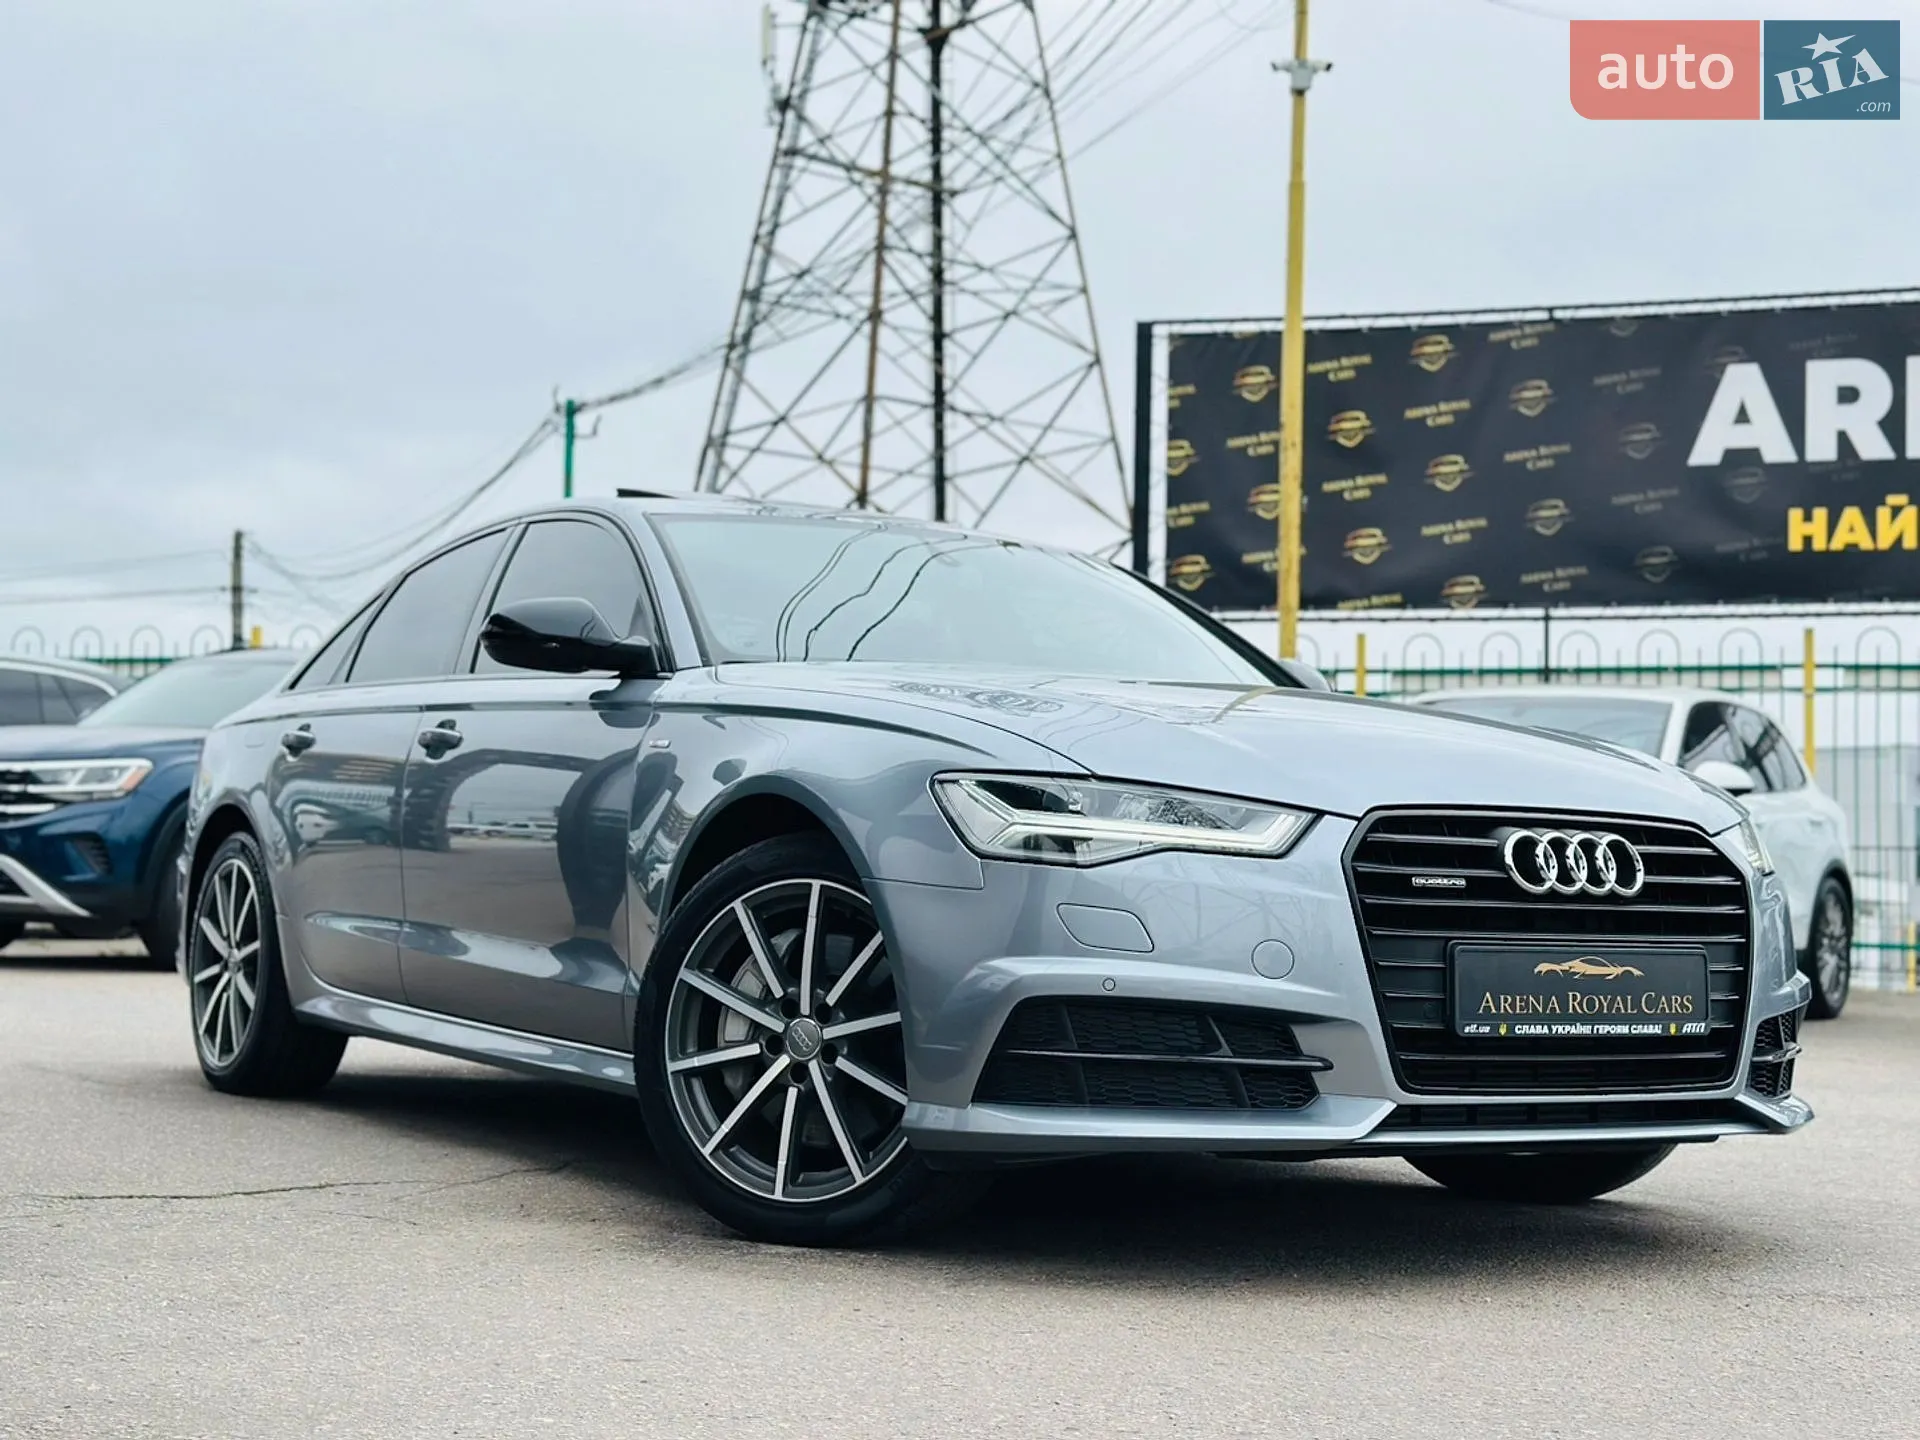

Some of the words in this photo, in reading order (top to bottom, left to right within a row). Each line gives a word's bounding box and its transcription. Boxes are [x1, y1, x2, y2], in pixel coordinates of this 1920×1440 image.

[1686, 354, 1920, 466] AR
[1787, 494, 1919, 552] НАЙ
[1477, 991, 1561, 1014] ARENA
[1568, 991, 1638, 1014] ROYAL
[1641, 991, 1694, 1014] CARS
[1514, 1024, 1549, 1034] СЛАВА
